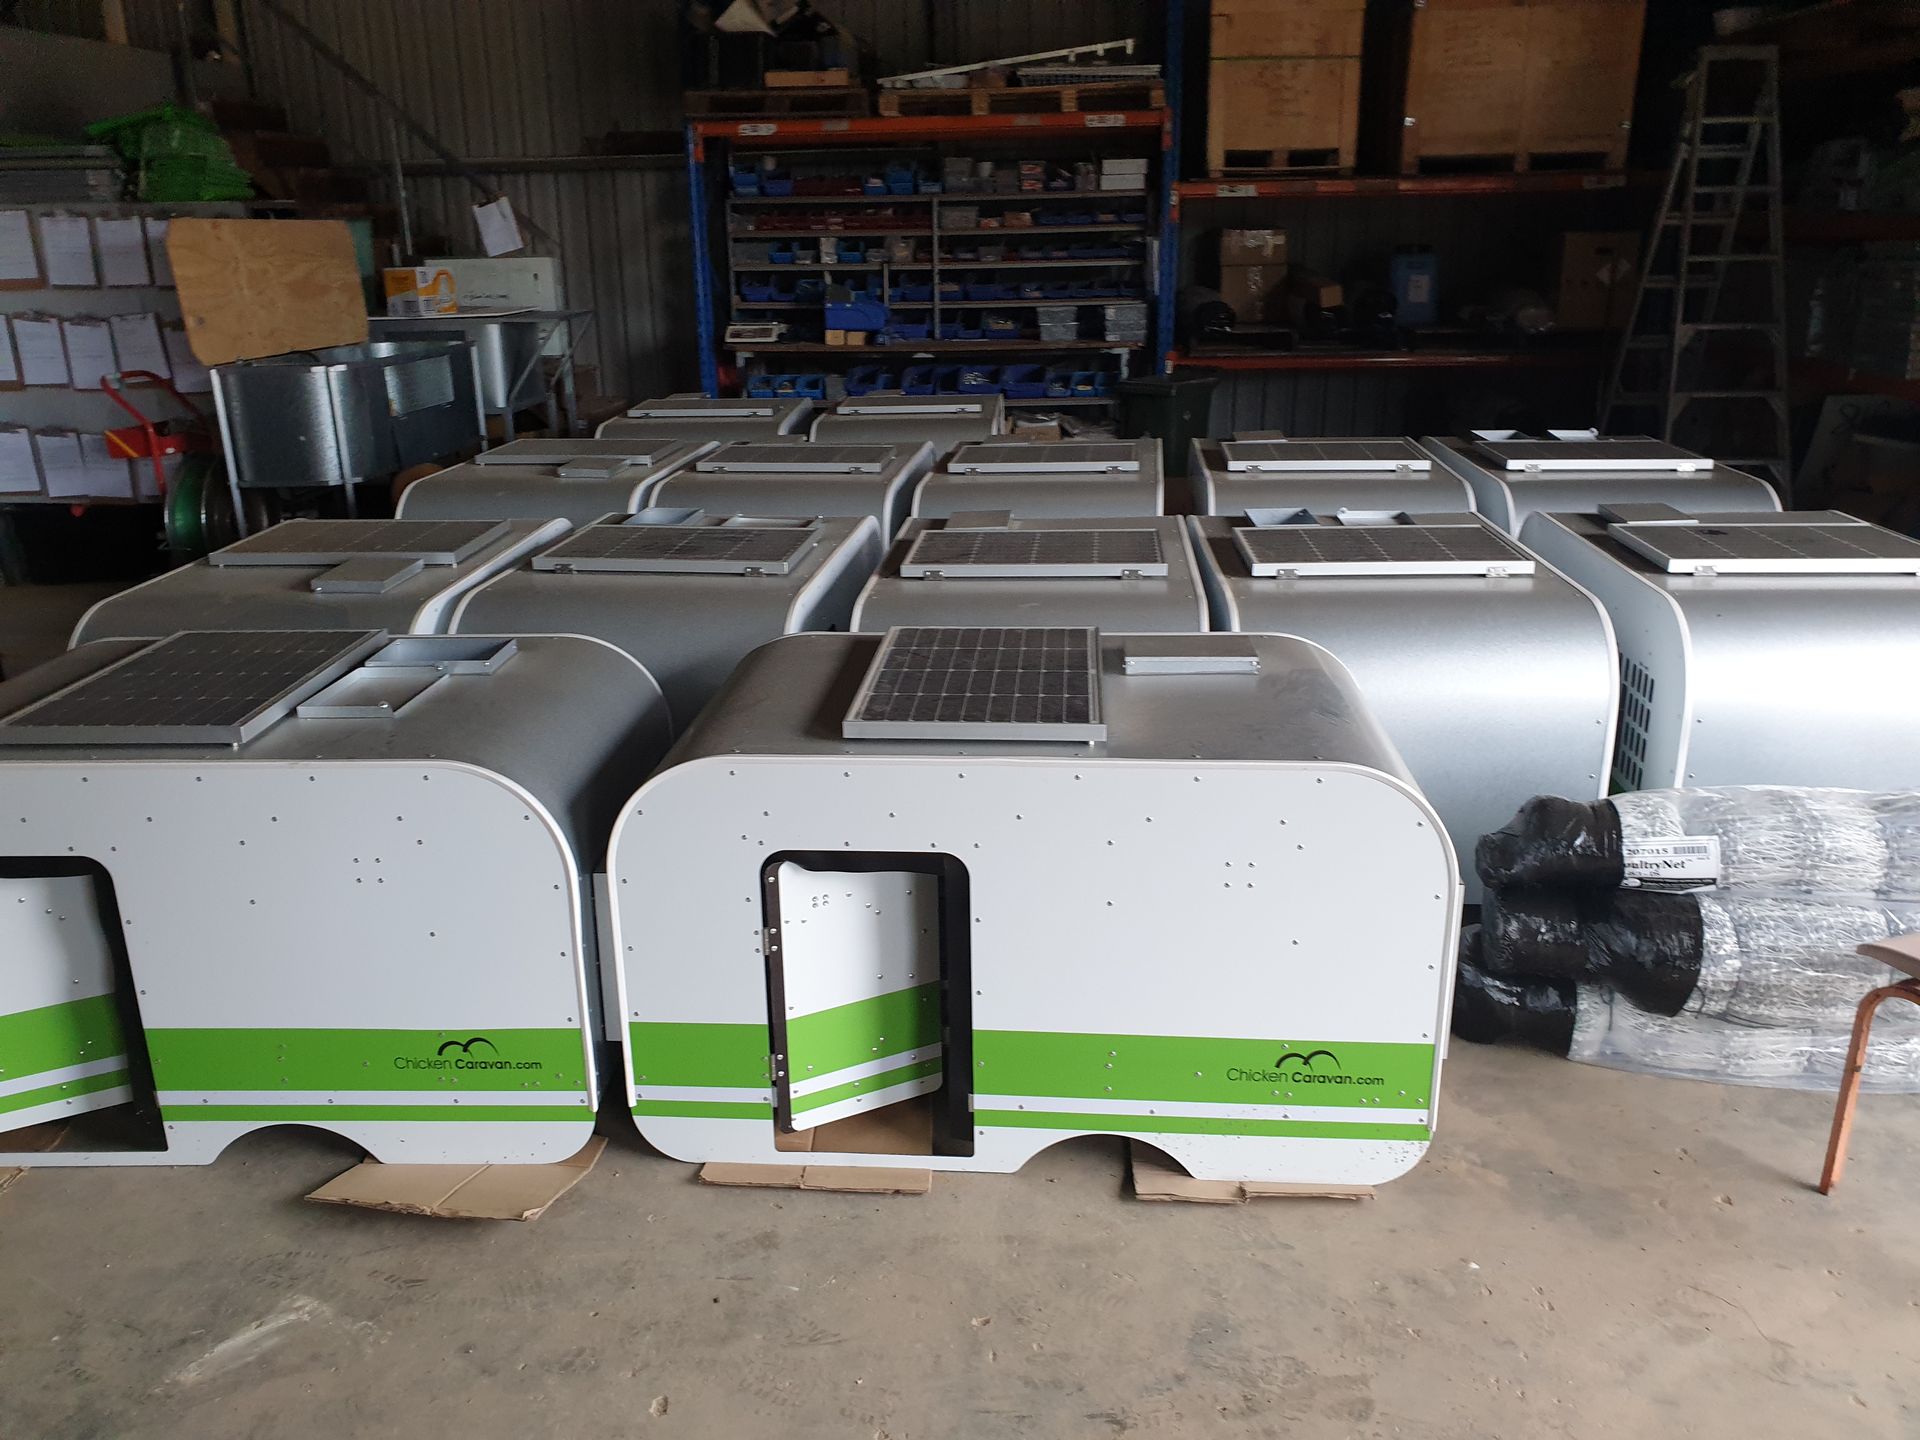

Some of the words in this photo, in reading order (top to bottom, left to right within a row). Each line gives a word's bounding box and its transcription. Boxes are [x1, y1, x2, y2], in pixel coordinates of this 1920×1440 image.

[1623, 860, 1686, 870] oultryNet
[394, 1056, 451, 1070] Chicken
[455, 1058, 542, 1070] Caravan.com
[1226, 1067, 1288, 1083] Chicken
[1292, 1071, 1385, 1086] Caravan.com
